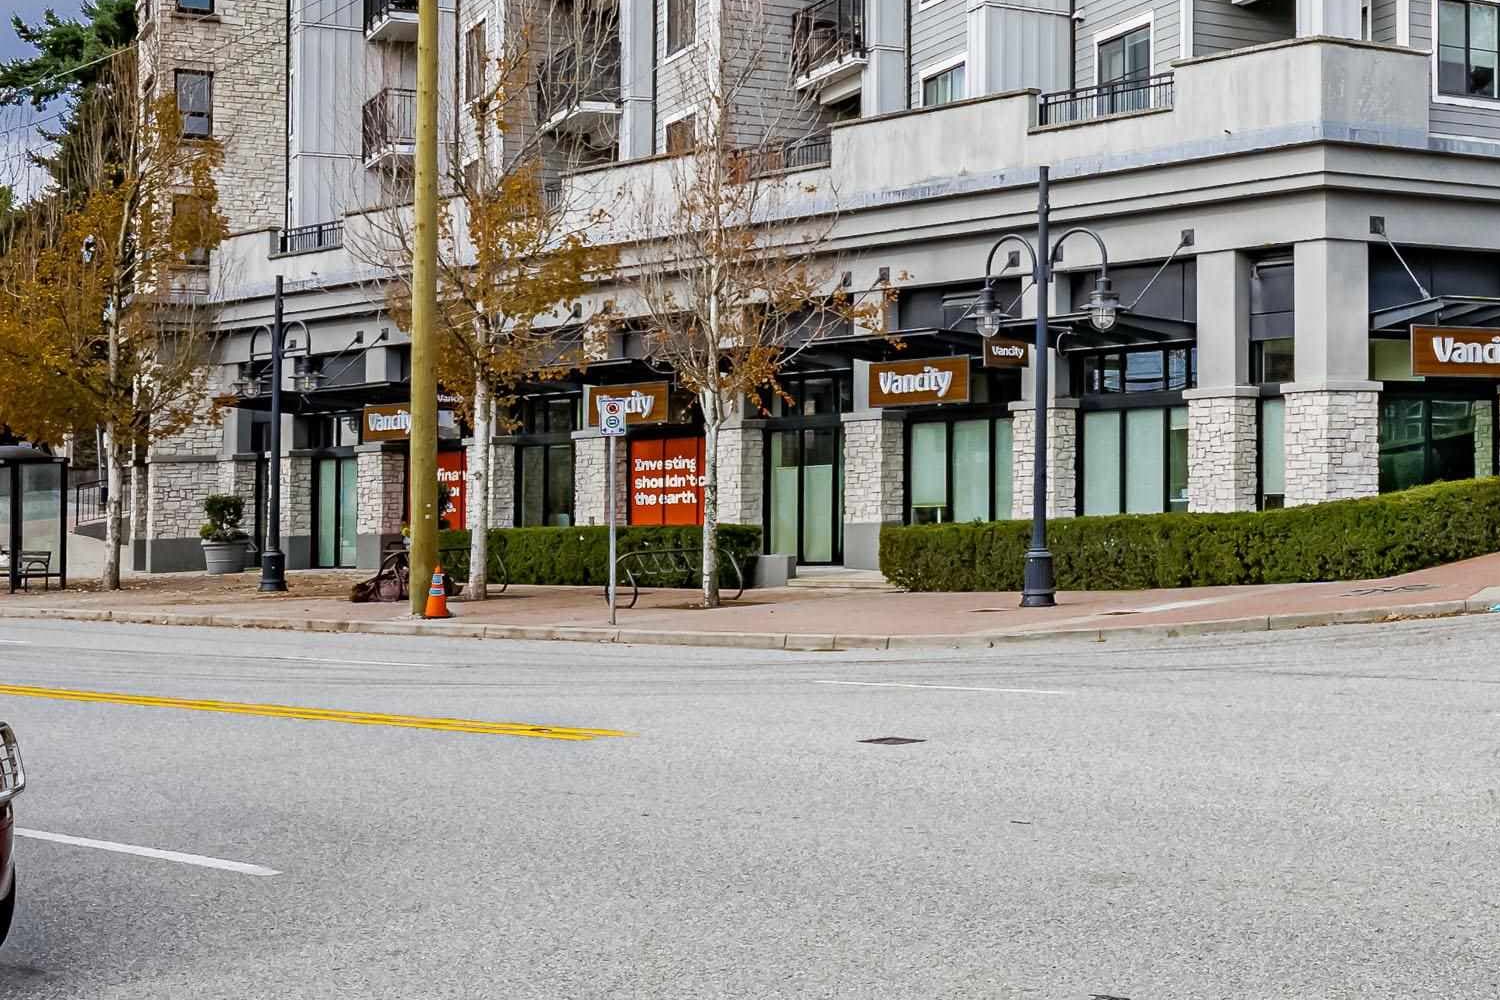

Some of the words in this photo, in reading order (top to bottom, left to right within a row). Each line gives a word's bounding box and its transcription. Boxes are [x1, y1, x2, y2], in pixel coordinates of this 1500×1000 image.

[992, 345, 1024, 359] Vancity
[879, 366, 953, 398] Vancity
[635, 456, 697, 473] Investing
[635, 474, 697, 489] shouldn't
[635, 491, 657, 505] the
[658, 490, 697, 505] earth.
